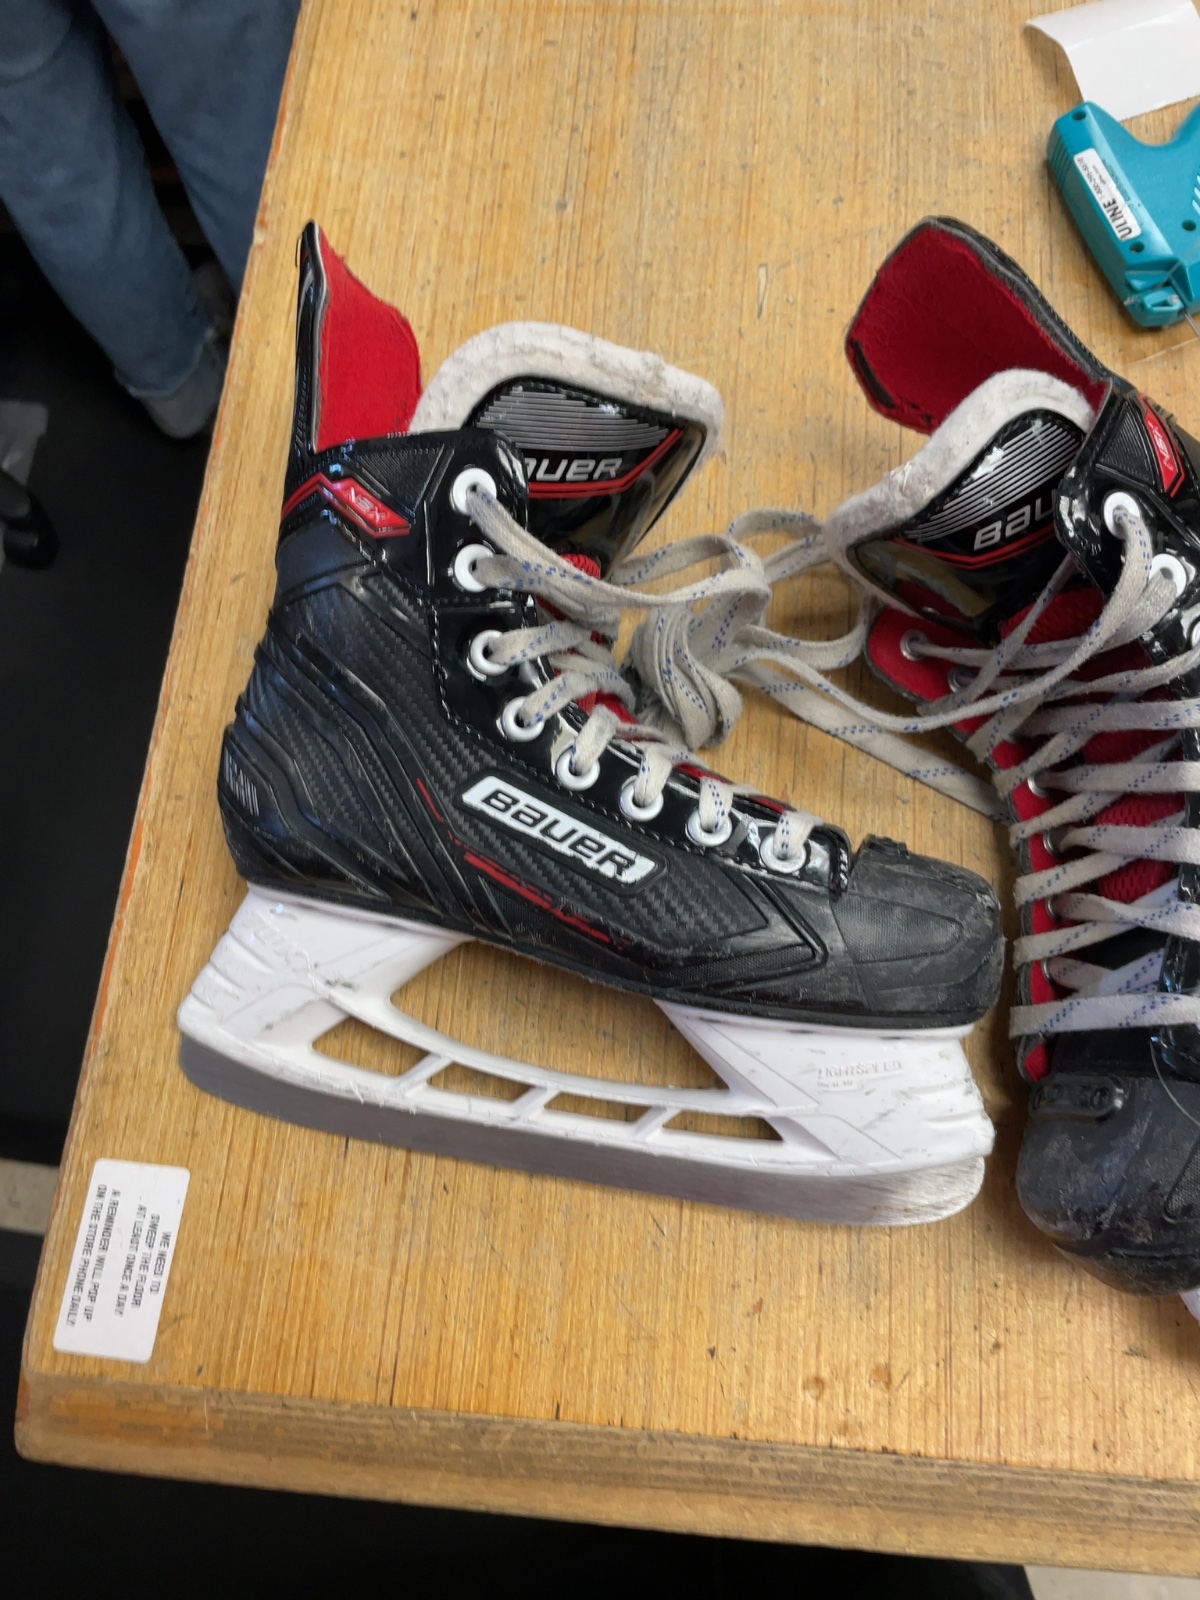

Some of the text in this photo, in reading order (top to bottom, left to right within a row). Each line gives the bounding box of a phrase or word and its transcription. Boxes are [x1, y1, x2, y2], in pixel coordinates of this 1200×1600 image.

[1103, 198, 1132, 240] ULINE
[972, 487, 1056, 552] BAU
[480, 788, 636, 876] BAUER
[98, 1198, 119, 1252] REMINDER
[136, 1204, 147, 1218] AT
[129, 1220, 144, 1253] LEAST
[66, 1184, 107, 1327] ON THE STORE PHONE DAILY
[91, 1254, 106, 1280] WILL
[121, 1256, 136, 1284] ONCE
[131, 1213, 160, 1308] SWEEP THE FLOOR
[150, 1231, 172, 1295] WE NEED TO
[87, 1281, 100, 1304] POP
[114, 1295, 127, 1317] DAY
[83, 1305, 94, 1322] UP
